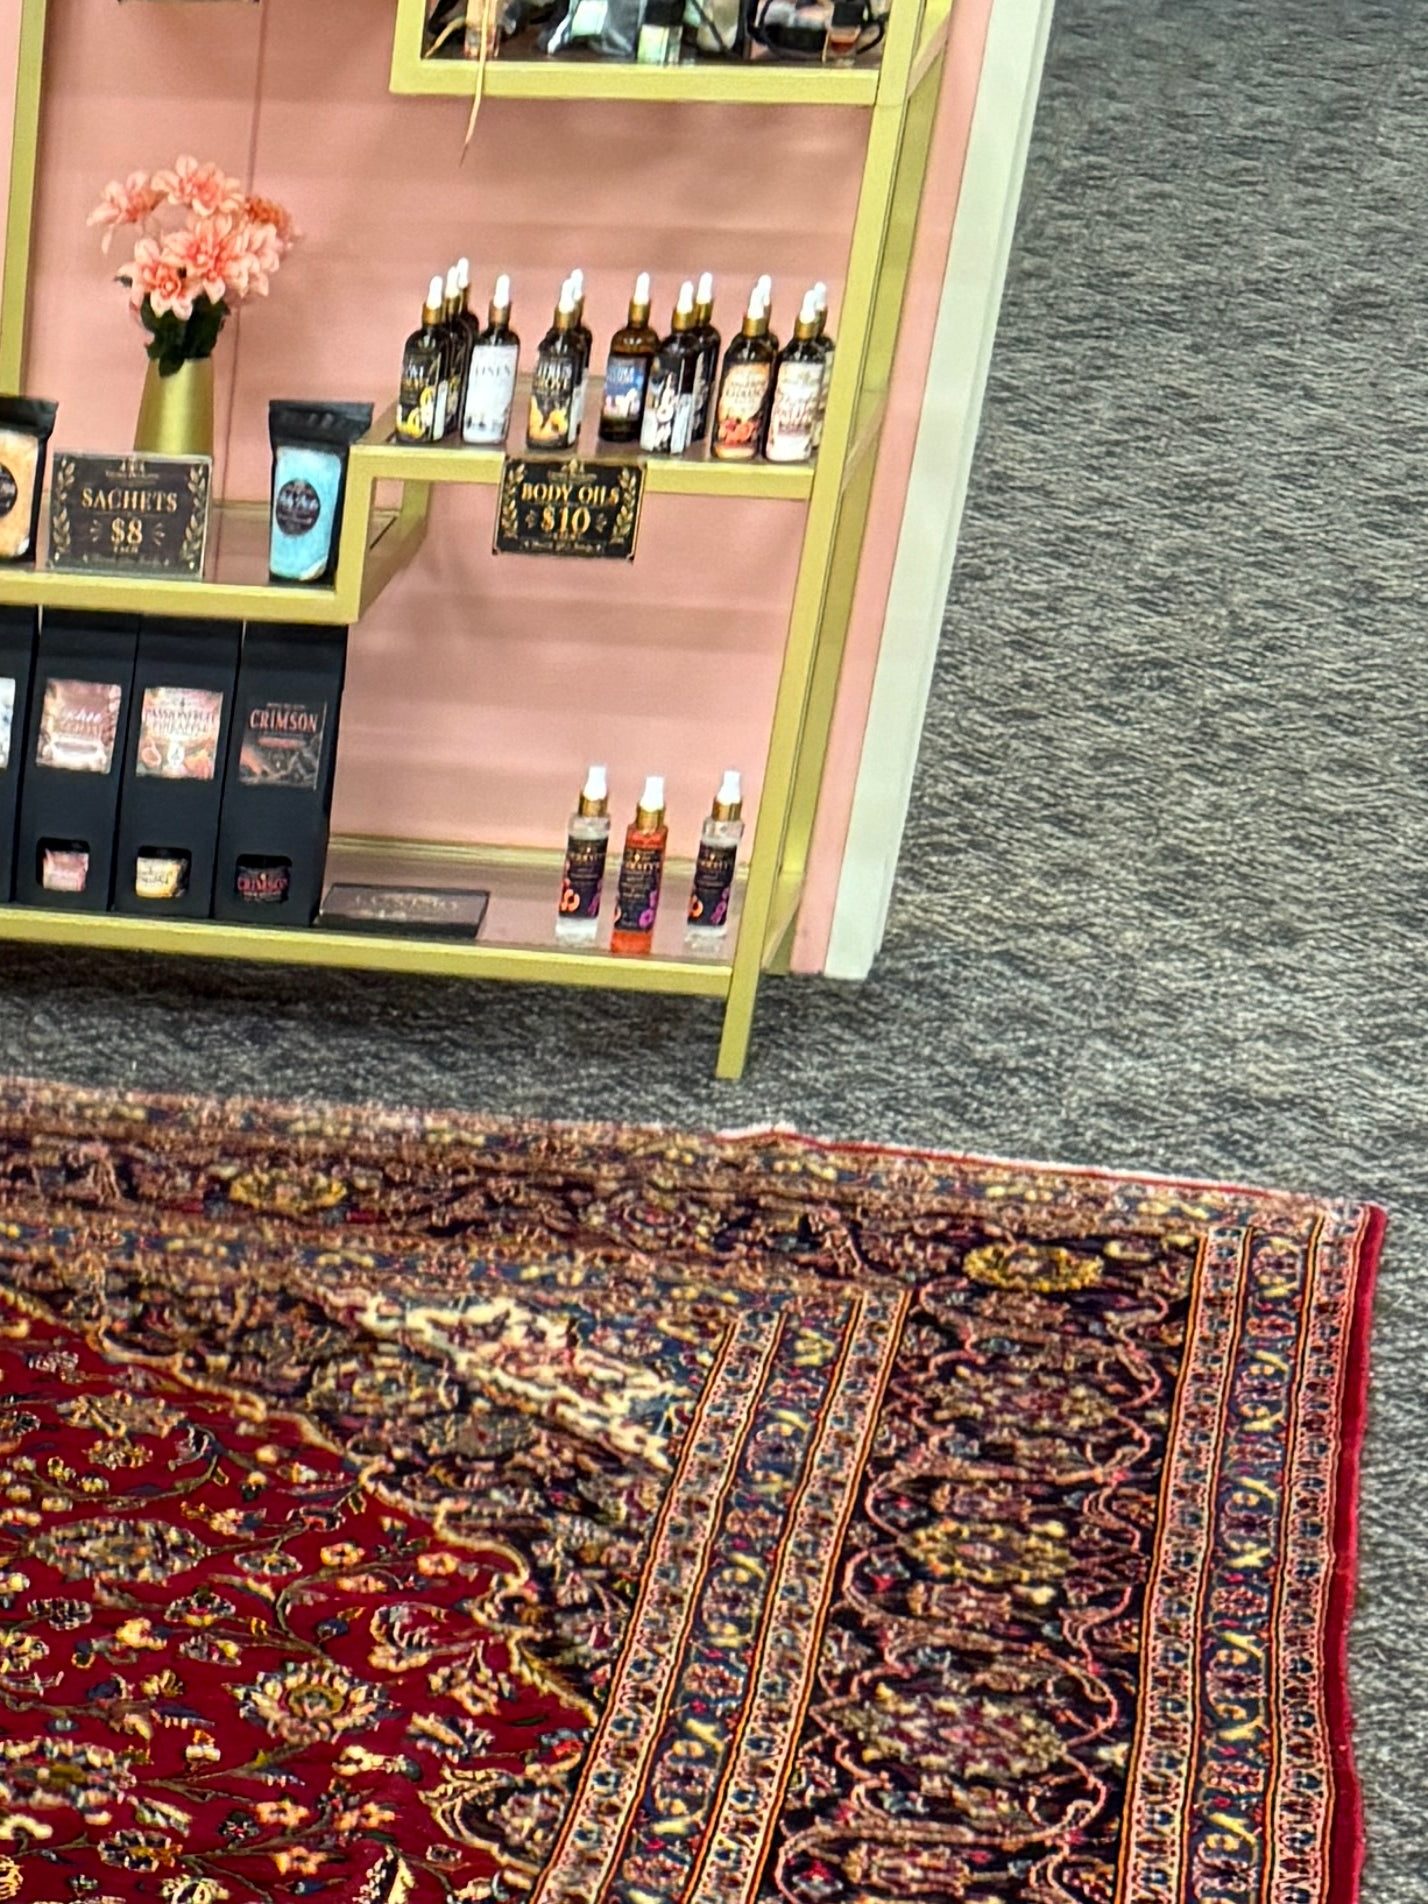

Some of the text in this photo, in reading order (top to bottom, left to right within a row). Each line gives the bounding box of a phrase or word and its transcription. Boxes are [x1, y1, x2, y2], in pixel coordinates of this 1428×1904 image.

[81, 487, 178, 513] SACHETS
[521, 482, 620, 505] BODY OILS
[111, 517, 143, 545] $8
[540, 505, 591, 534] $10
[250, 709, 319, 732] CRIMSON
